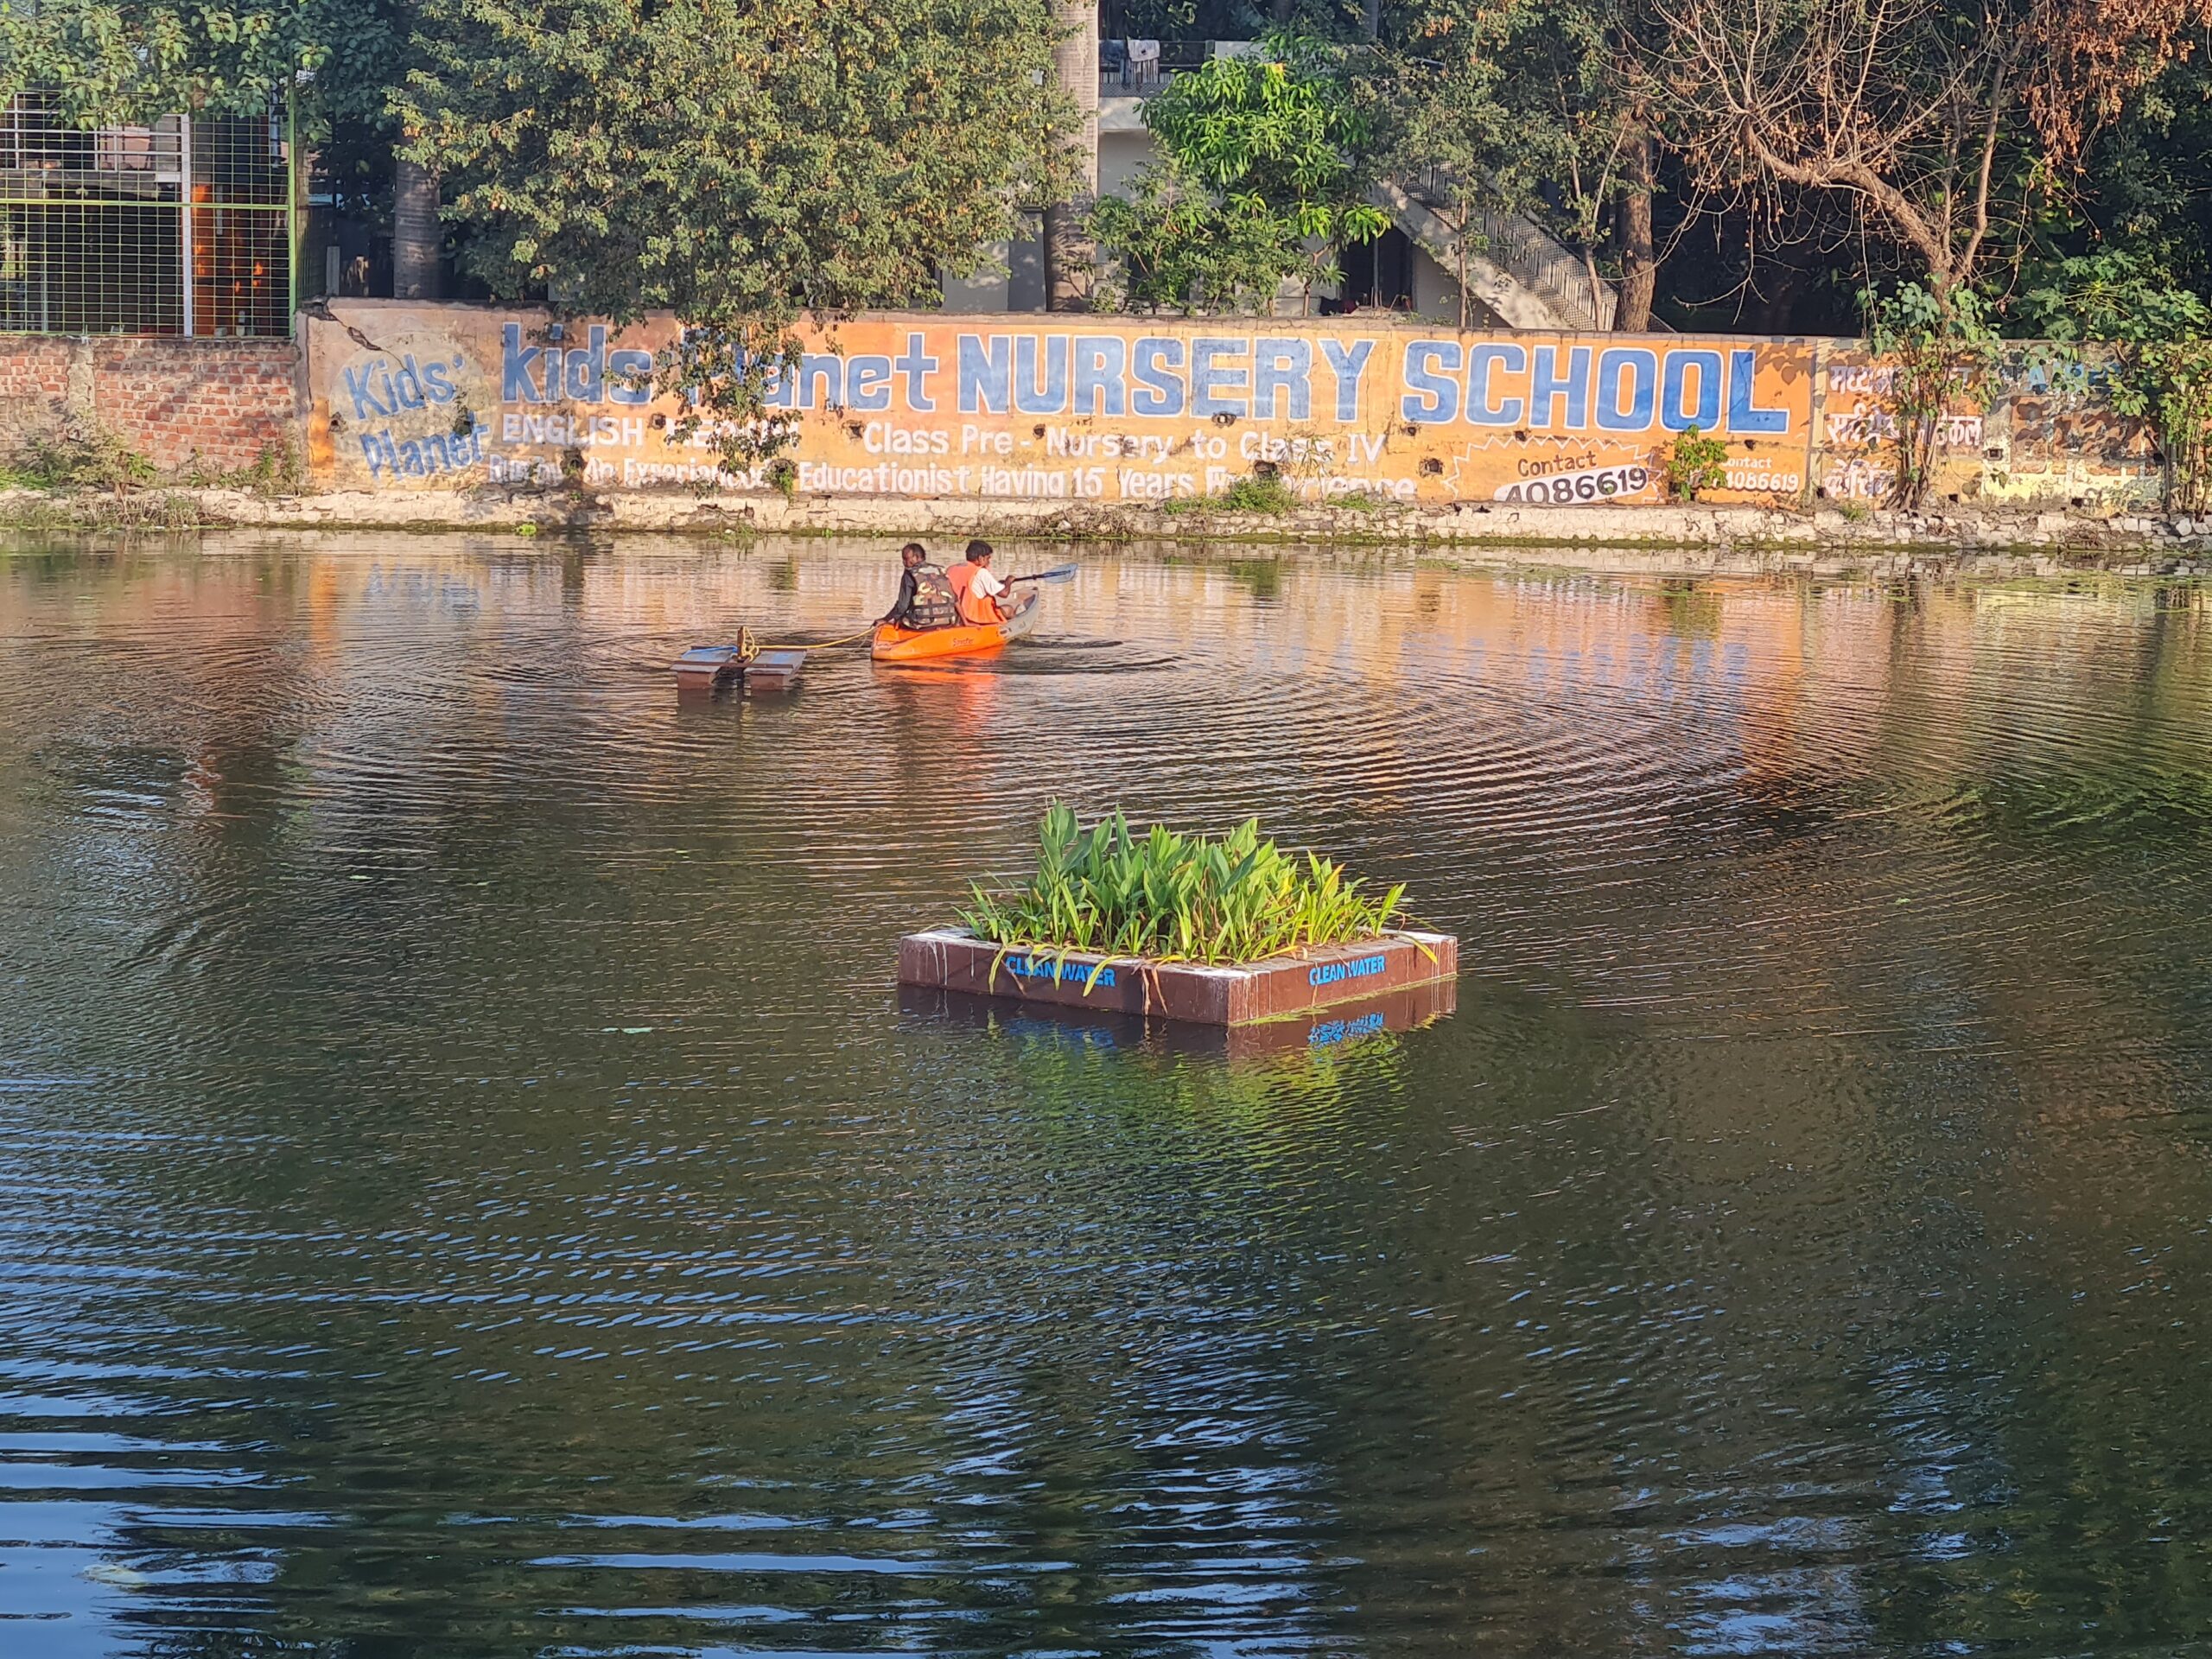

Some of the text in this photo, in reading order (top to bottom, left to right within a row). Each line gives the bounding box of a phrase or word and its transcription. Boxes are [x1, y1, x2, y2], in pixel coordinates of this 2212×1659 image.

[343, 353, 466, 420] Kids'
[501, 321, 673, 406] kids
[957, 333, 1376, 423] NURSERY
[1400, 339, 1791, 434] SCHOOL
[359, 409, 490, 481] Planet
[502, 413, 645, 448] ENGLISH
[864, 421, 950, 455] Class
[962, 423, 1013, 455] Pre
[1046, 426, 1173, 465] Nursery
[1193, 429, 1228, 460] to
[1346, 433, 1386, 464] IV
[798, 461, 971, 495] Educationist
[1073, 466, 1107, 497] 15
[1120, 467, 1195, 499] Years
[1518, 449, 1598, 477] Contact
[1005, 955, 1116, 987] CLAN WATER
[1309, 954, 1385, 986] CLEAN WATER
